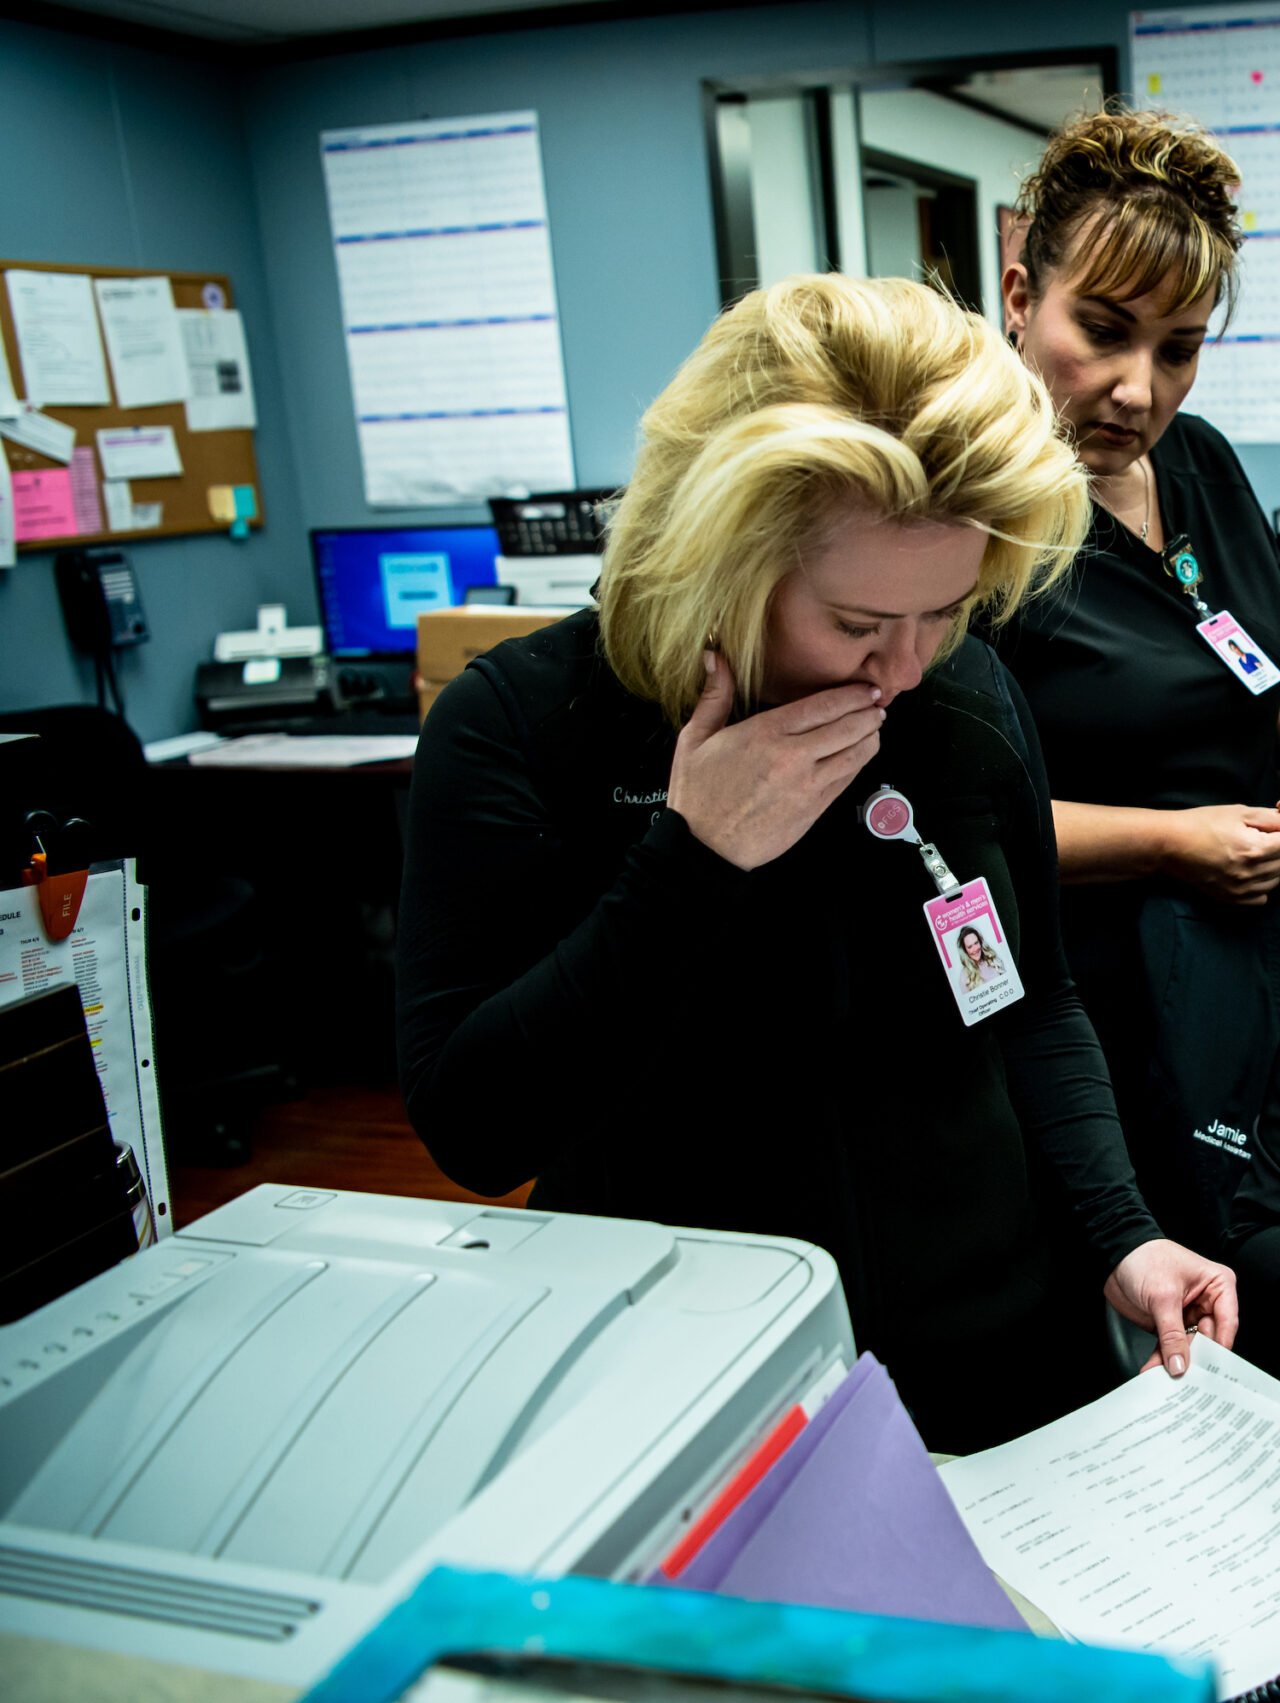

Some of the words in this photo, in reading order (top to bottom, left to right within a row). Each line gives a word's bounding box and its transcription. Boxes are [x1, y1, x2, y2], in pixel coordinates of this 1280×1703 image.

[614, 786, 668, 804] Christie
[62, 893, 72, 917] FILE
[969, 990, 989, 1004] Christie
[1208, 1119, 1247, 1145] Jamie
